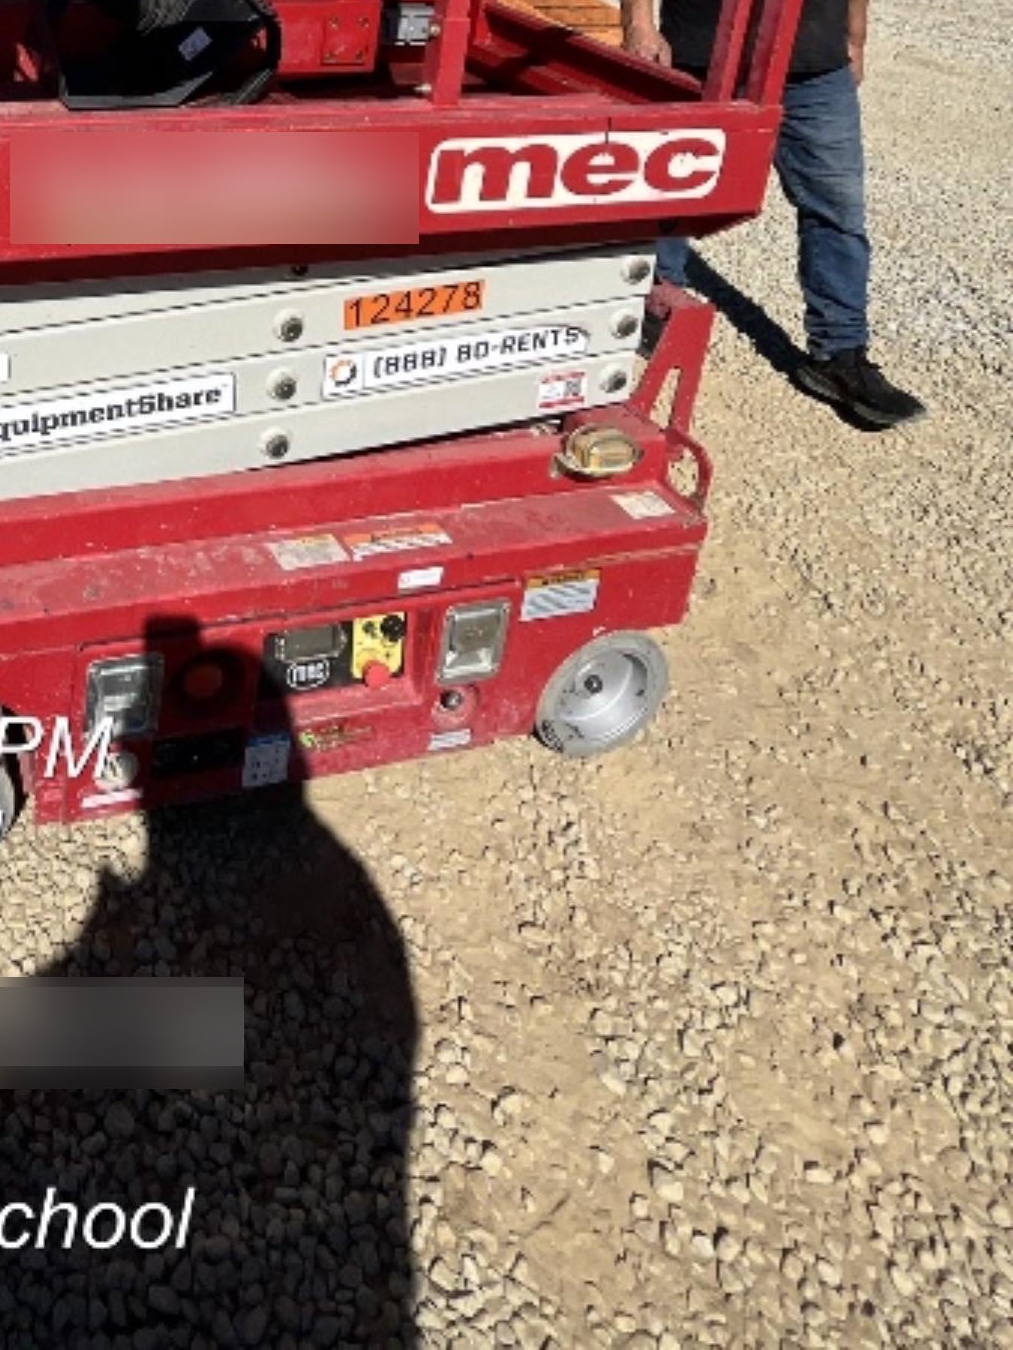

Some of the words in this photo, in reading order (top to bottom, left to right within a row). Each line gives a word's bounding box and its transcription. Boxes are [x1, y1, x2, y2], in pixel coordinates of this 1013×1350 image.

[430, 137, 719, 204] mec
[349, 282, 481, 327] 124278
[373, 347, 447, 379] (888)
